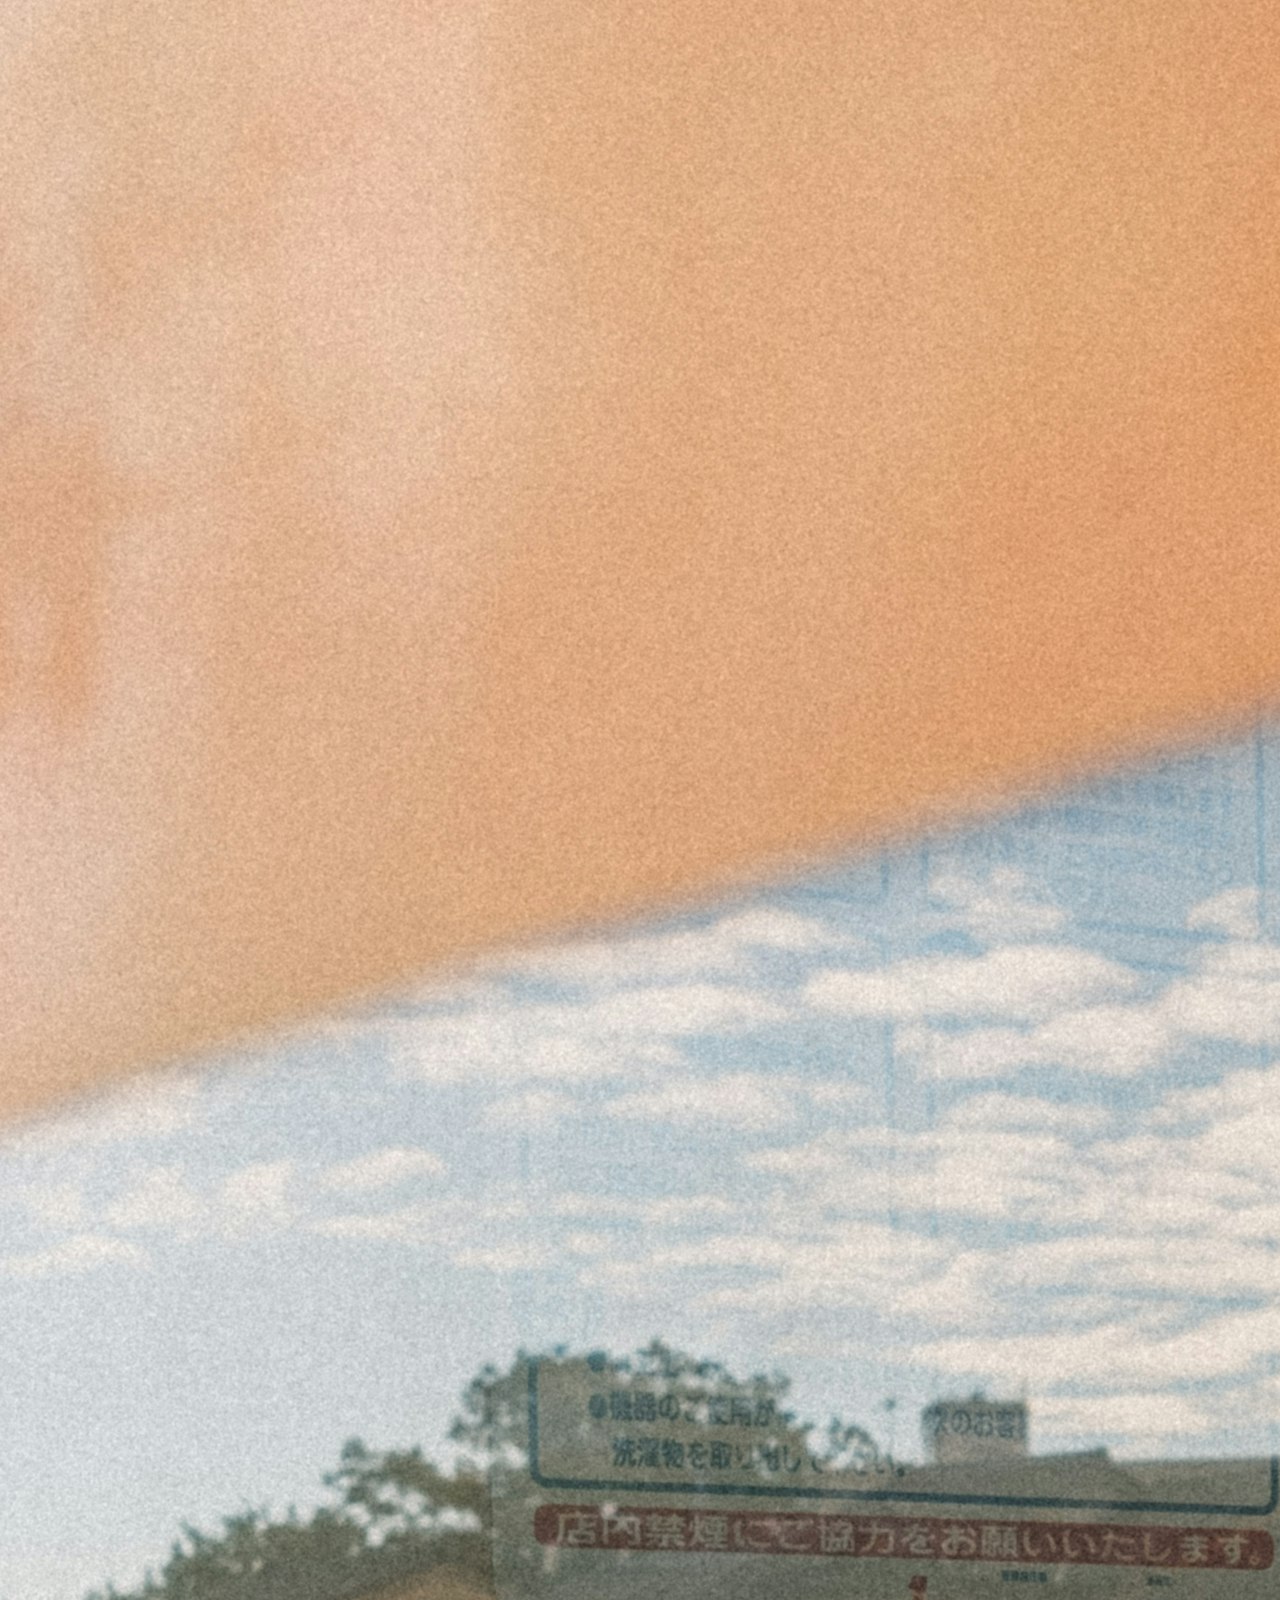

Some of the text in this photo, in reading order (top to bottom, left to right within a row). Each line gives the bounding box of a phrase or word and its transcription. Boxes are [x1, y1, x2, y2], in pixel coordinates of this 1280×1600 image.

[555, 1510, 1264, 1566] 店内禁煙にご協力をお願いいたします。
